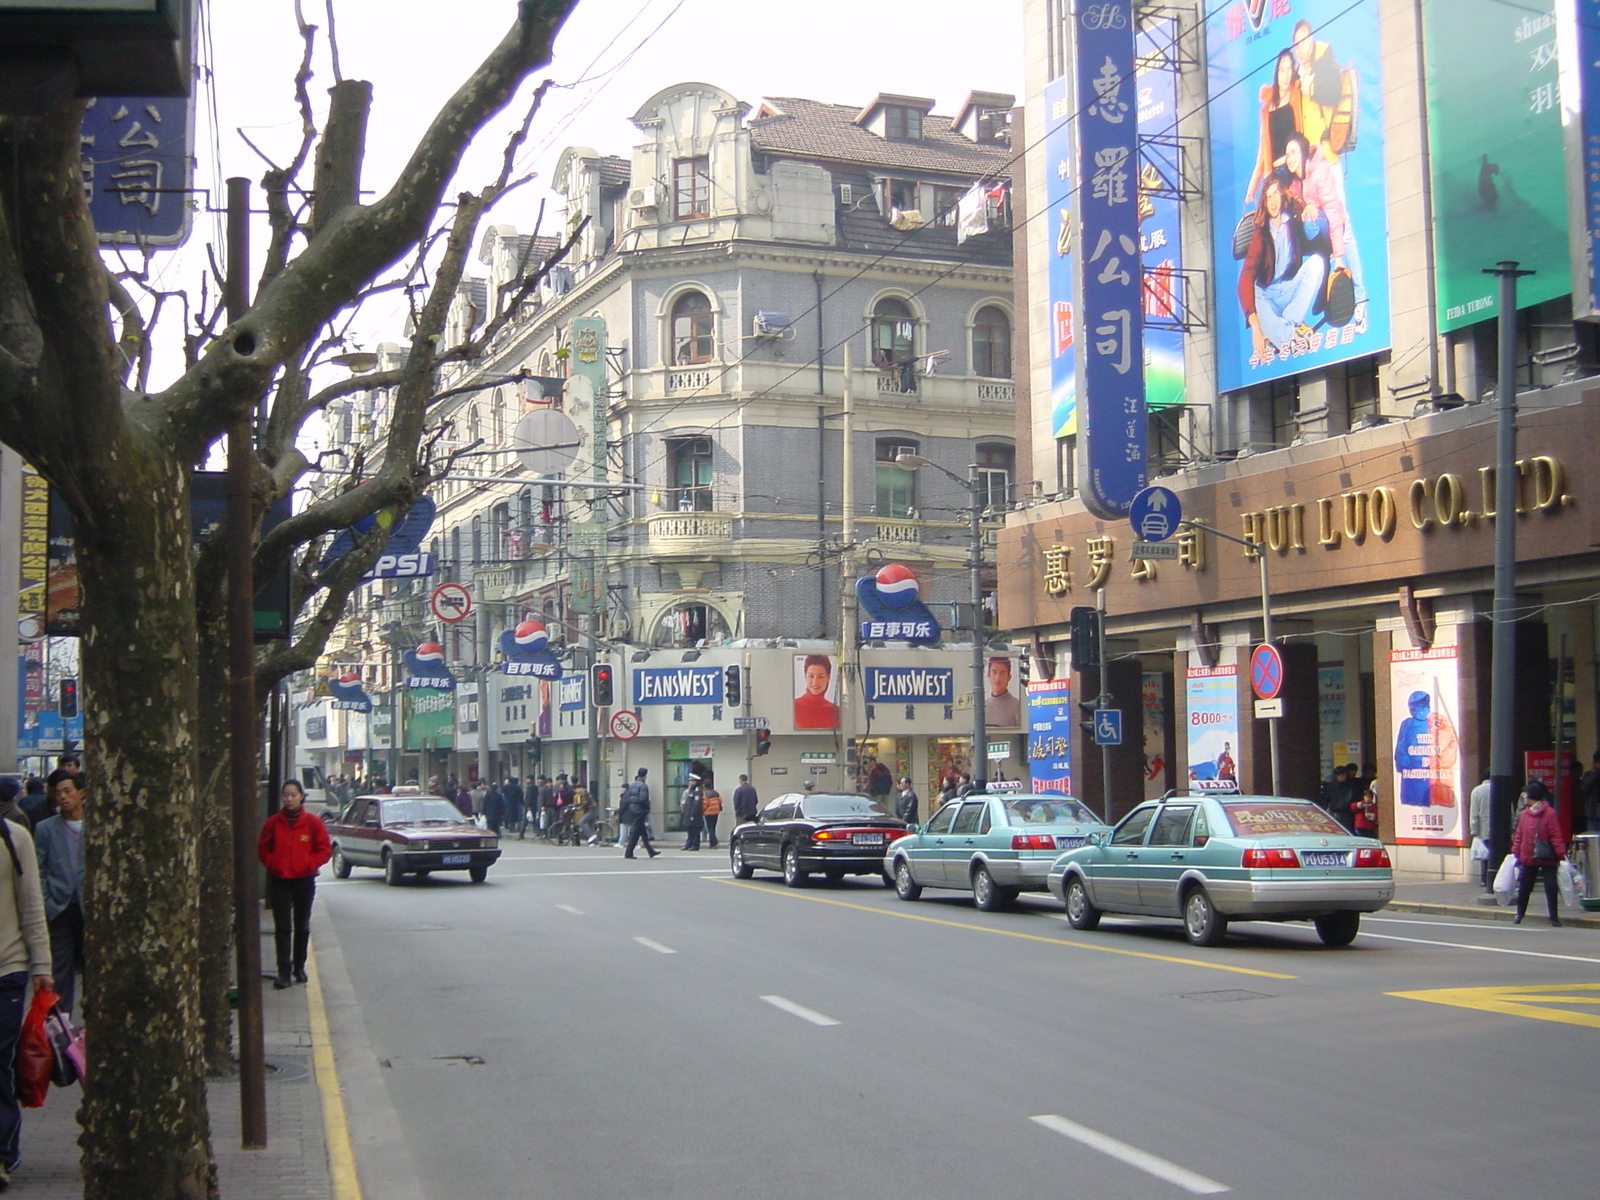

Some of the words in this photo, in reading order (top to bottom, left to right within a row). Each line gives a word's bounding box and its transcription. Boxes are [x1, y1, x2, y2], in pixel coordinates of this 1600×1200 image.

[1529, 79, 1561, 115] 羽
[112, 105, 164, 216] 公司
[1240, 502, 1305, 558] HUI
[1316, 486, 1396, 546] LUO
[869, 621, 931, 639] 百事可乐
[506, 662, 556, 677] 百事可乐
[409, 676, 451, 689] 百事可乐
[1191, 711, 1221, 726] 8000
[1197, 781, 1231, 789] TAXI
